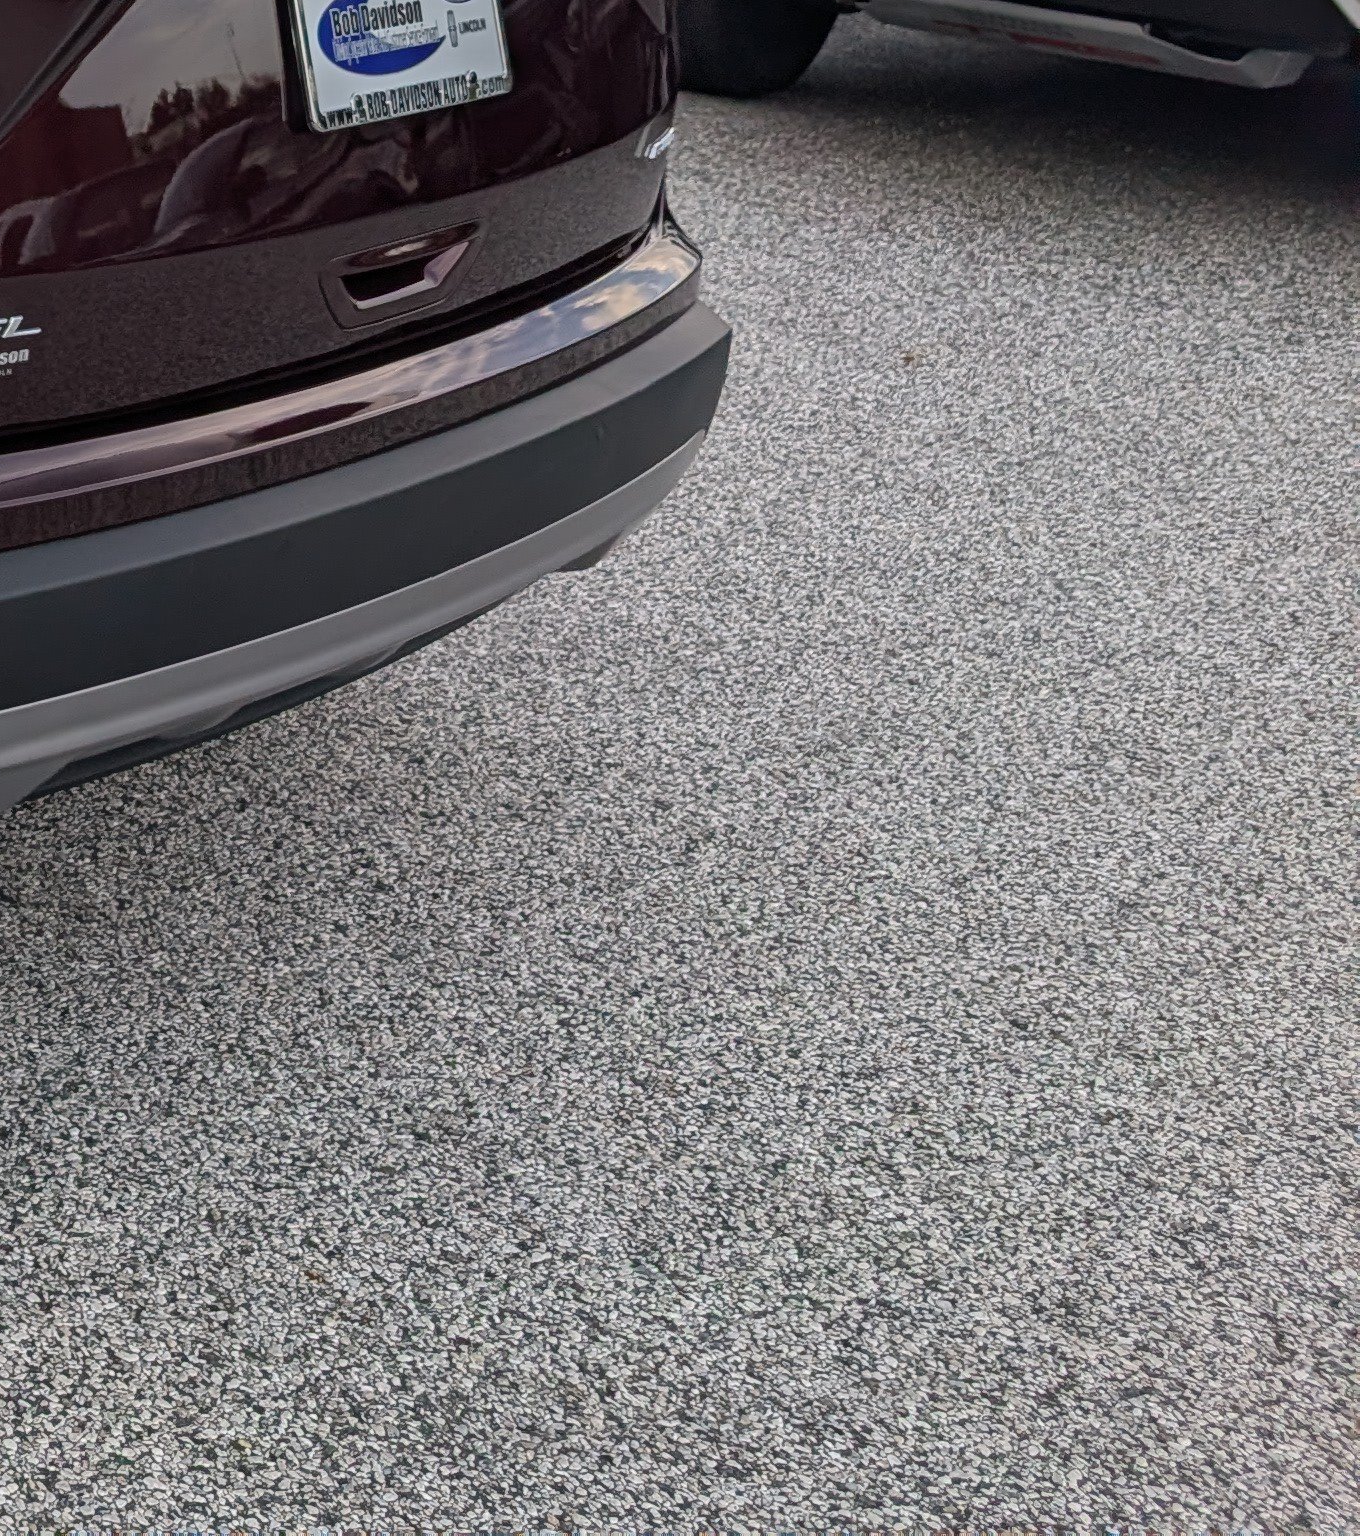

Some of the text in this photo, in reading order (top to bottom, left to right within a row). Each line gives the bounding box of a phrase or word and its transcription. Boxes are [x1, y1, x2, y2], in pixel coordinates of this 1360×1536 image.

[331, 0, 423, 37] Bob Davidson
[458, 18, 487, 33] LINCOLN
